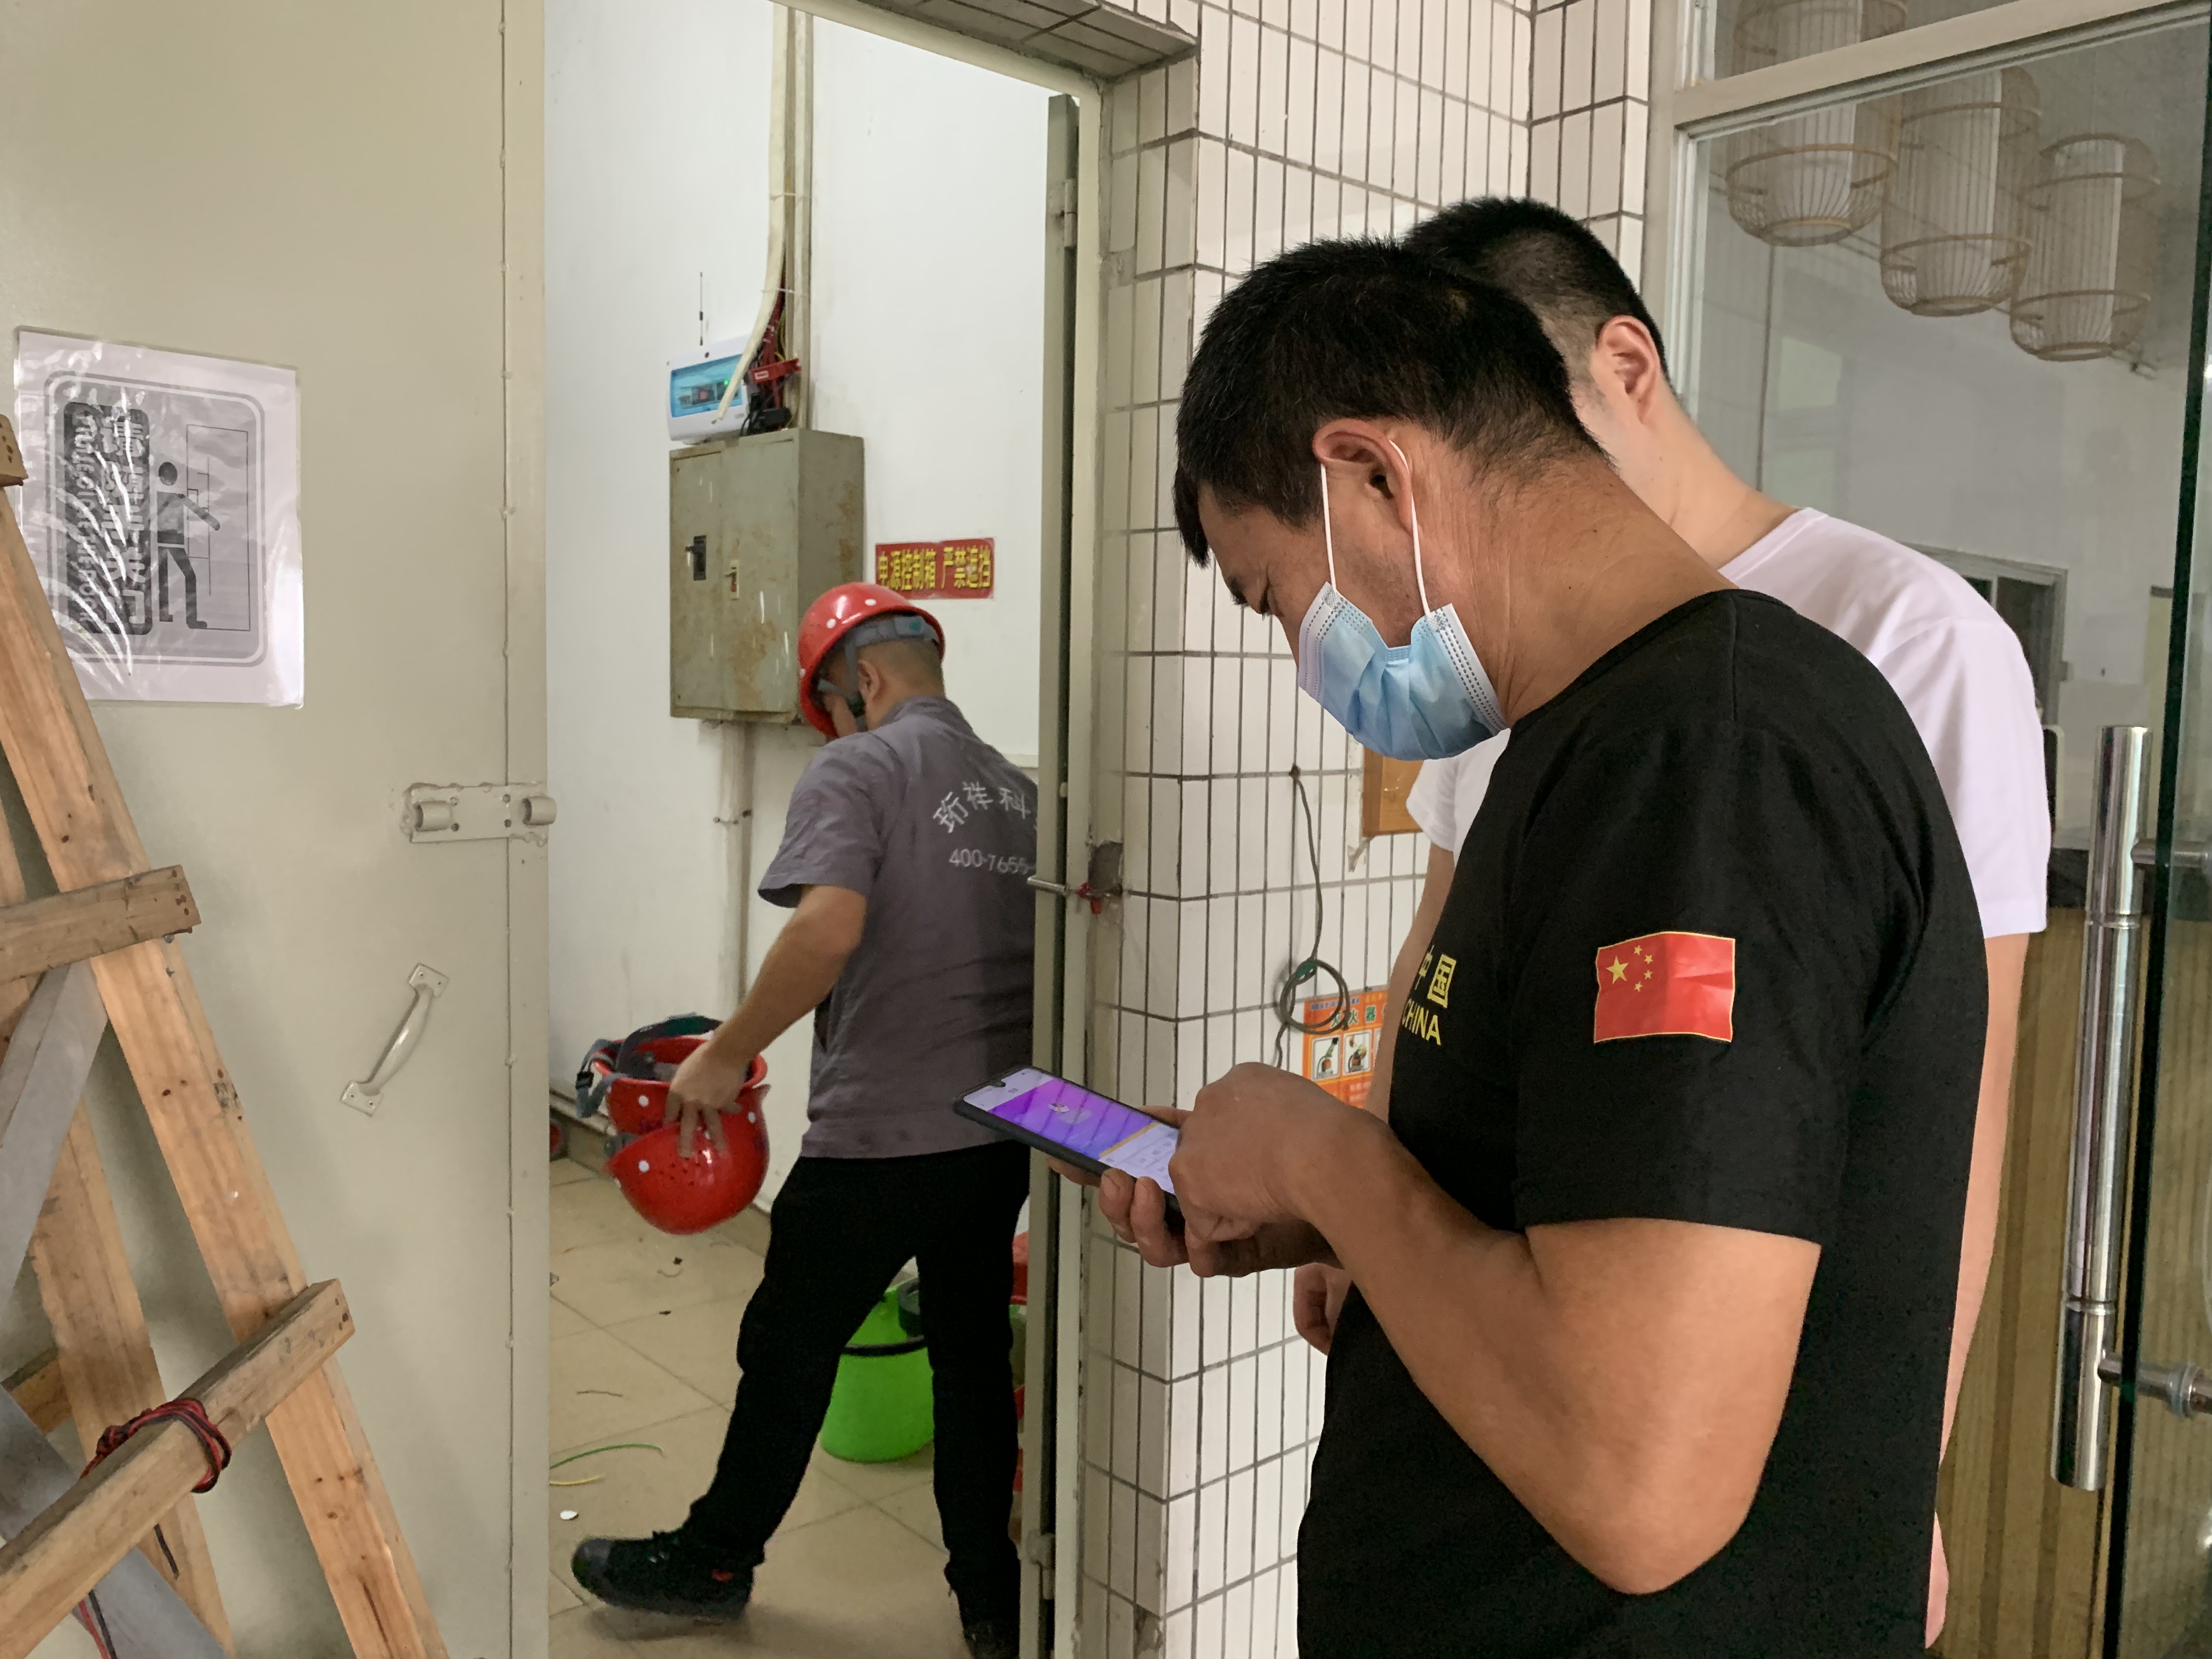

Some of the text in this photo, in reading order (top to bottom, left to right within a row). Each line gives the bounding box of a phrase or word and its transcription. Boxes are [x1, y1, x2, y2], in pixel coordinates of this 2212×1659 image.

[878, 548, 936, 591] 电源控制箱
[1414, 945, 1457, 1008] 中国
[1402, 998, 1442, 1046] CHINA
